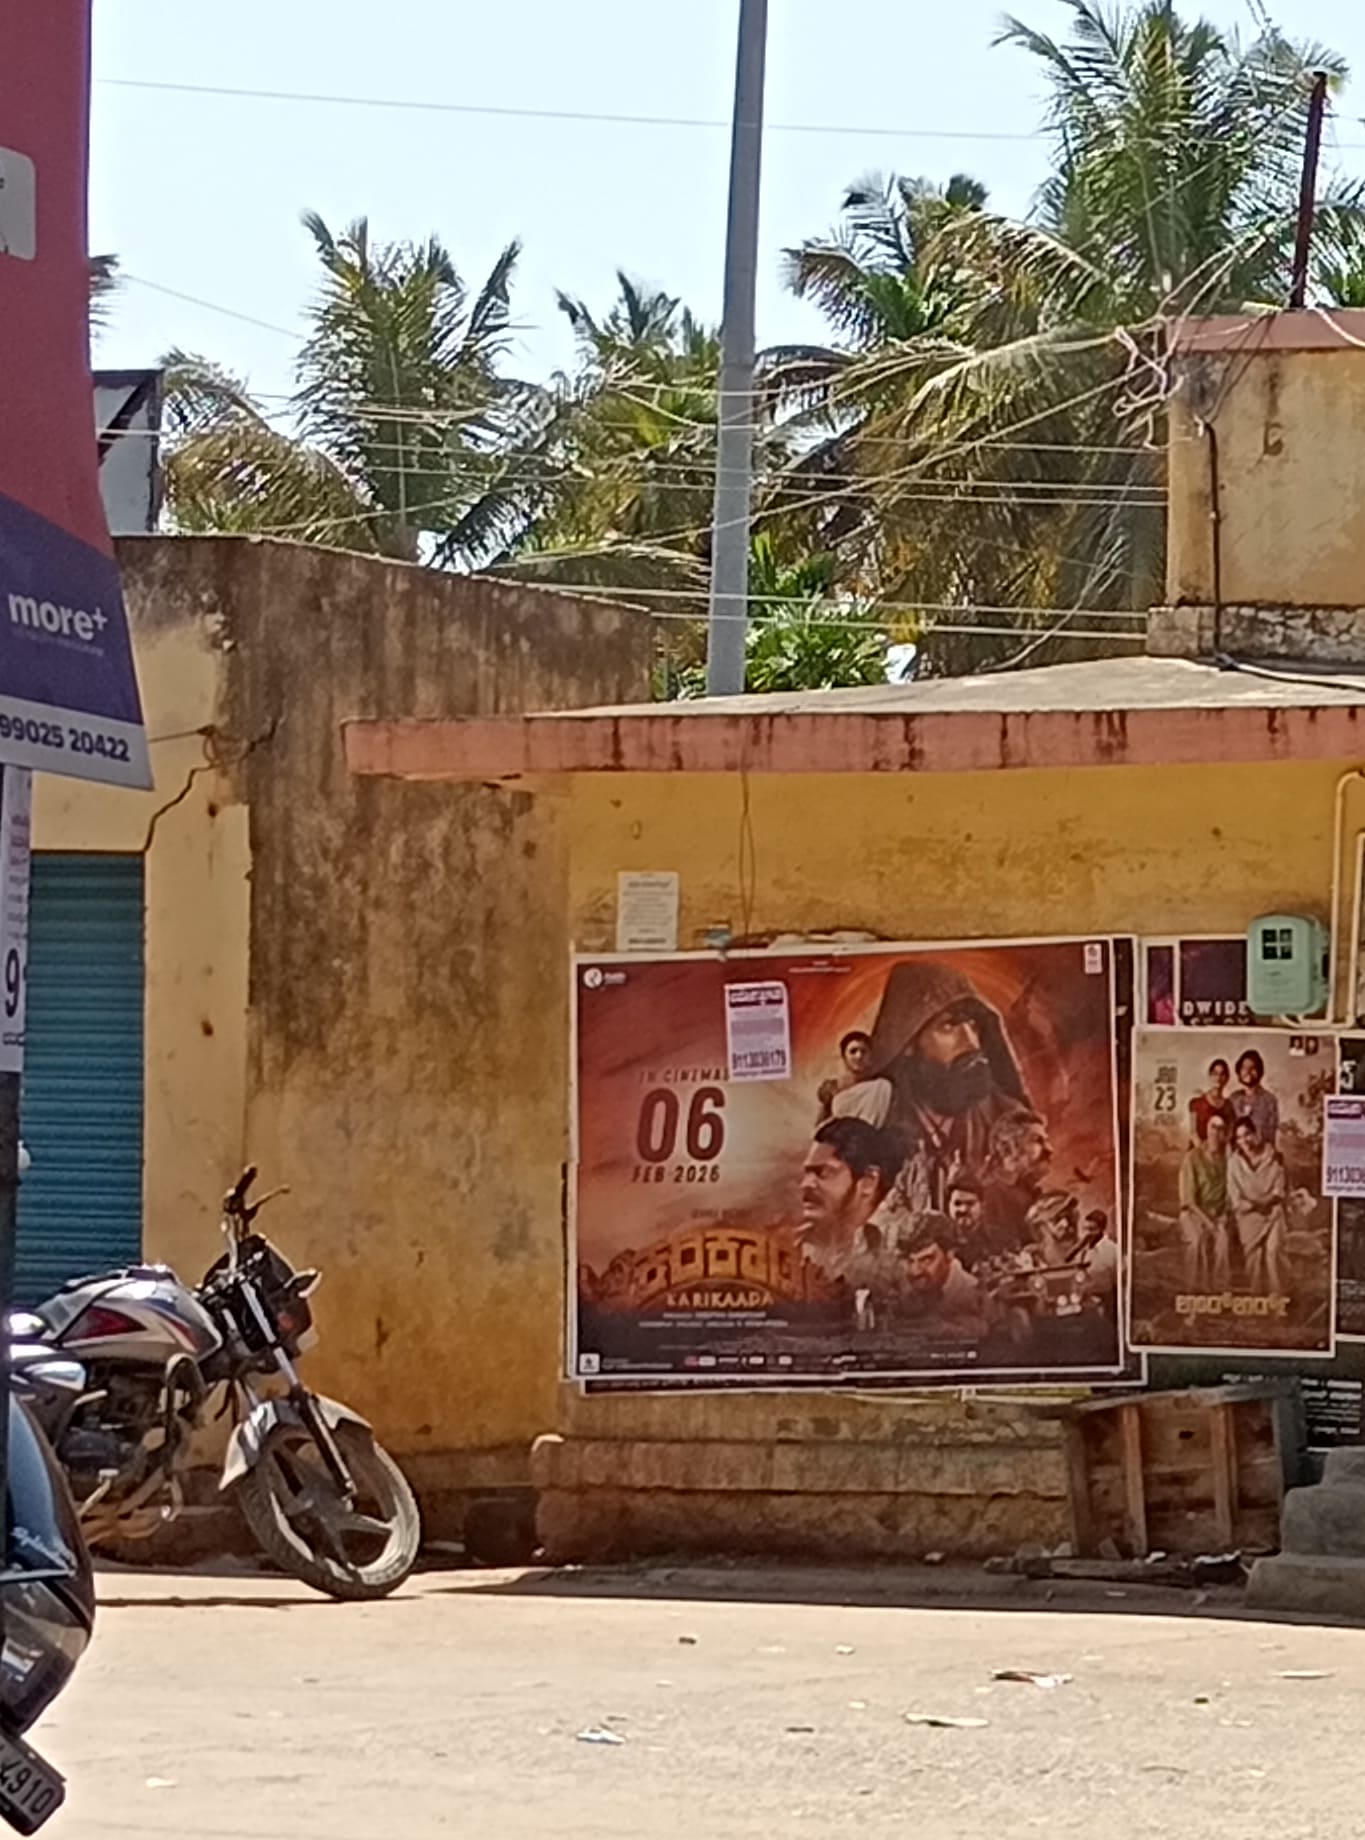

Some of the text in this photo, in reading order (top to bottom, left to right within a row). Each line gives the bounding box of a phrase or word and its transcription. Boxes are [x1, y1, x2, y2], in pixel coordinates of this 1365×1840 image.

[8, 593, 108, 640] more+
[0, 714, 131, 762] 99025 20422
[1154, 1086, 1177, 1112] 23
[636, 1086, 726, 1164] 06
[632, 1165, 720, 1183] FEB 2026
[667, 1291, 774, 1309] KARIKAADA
